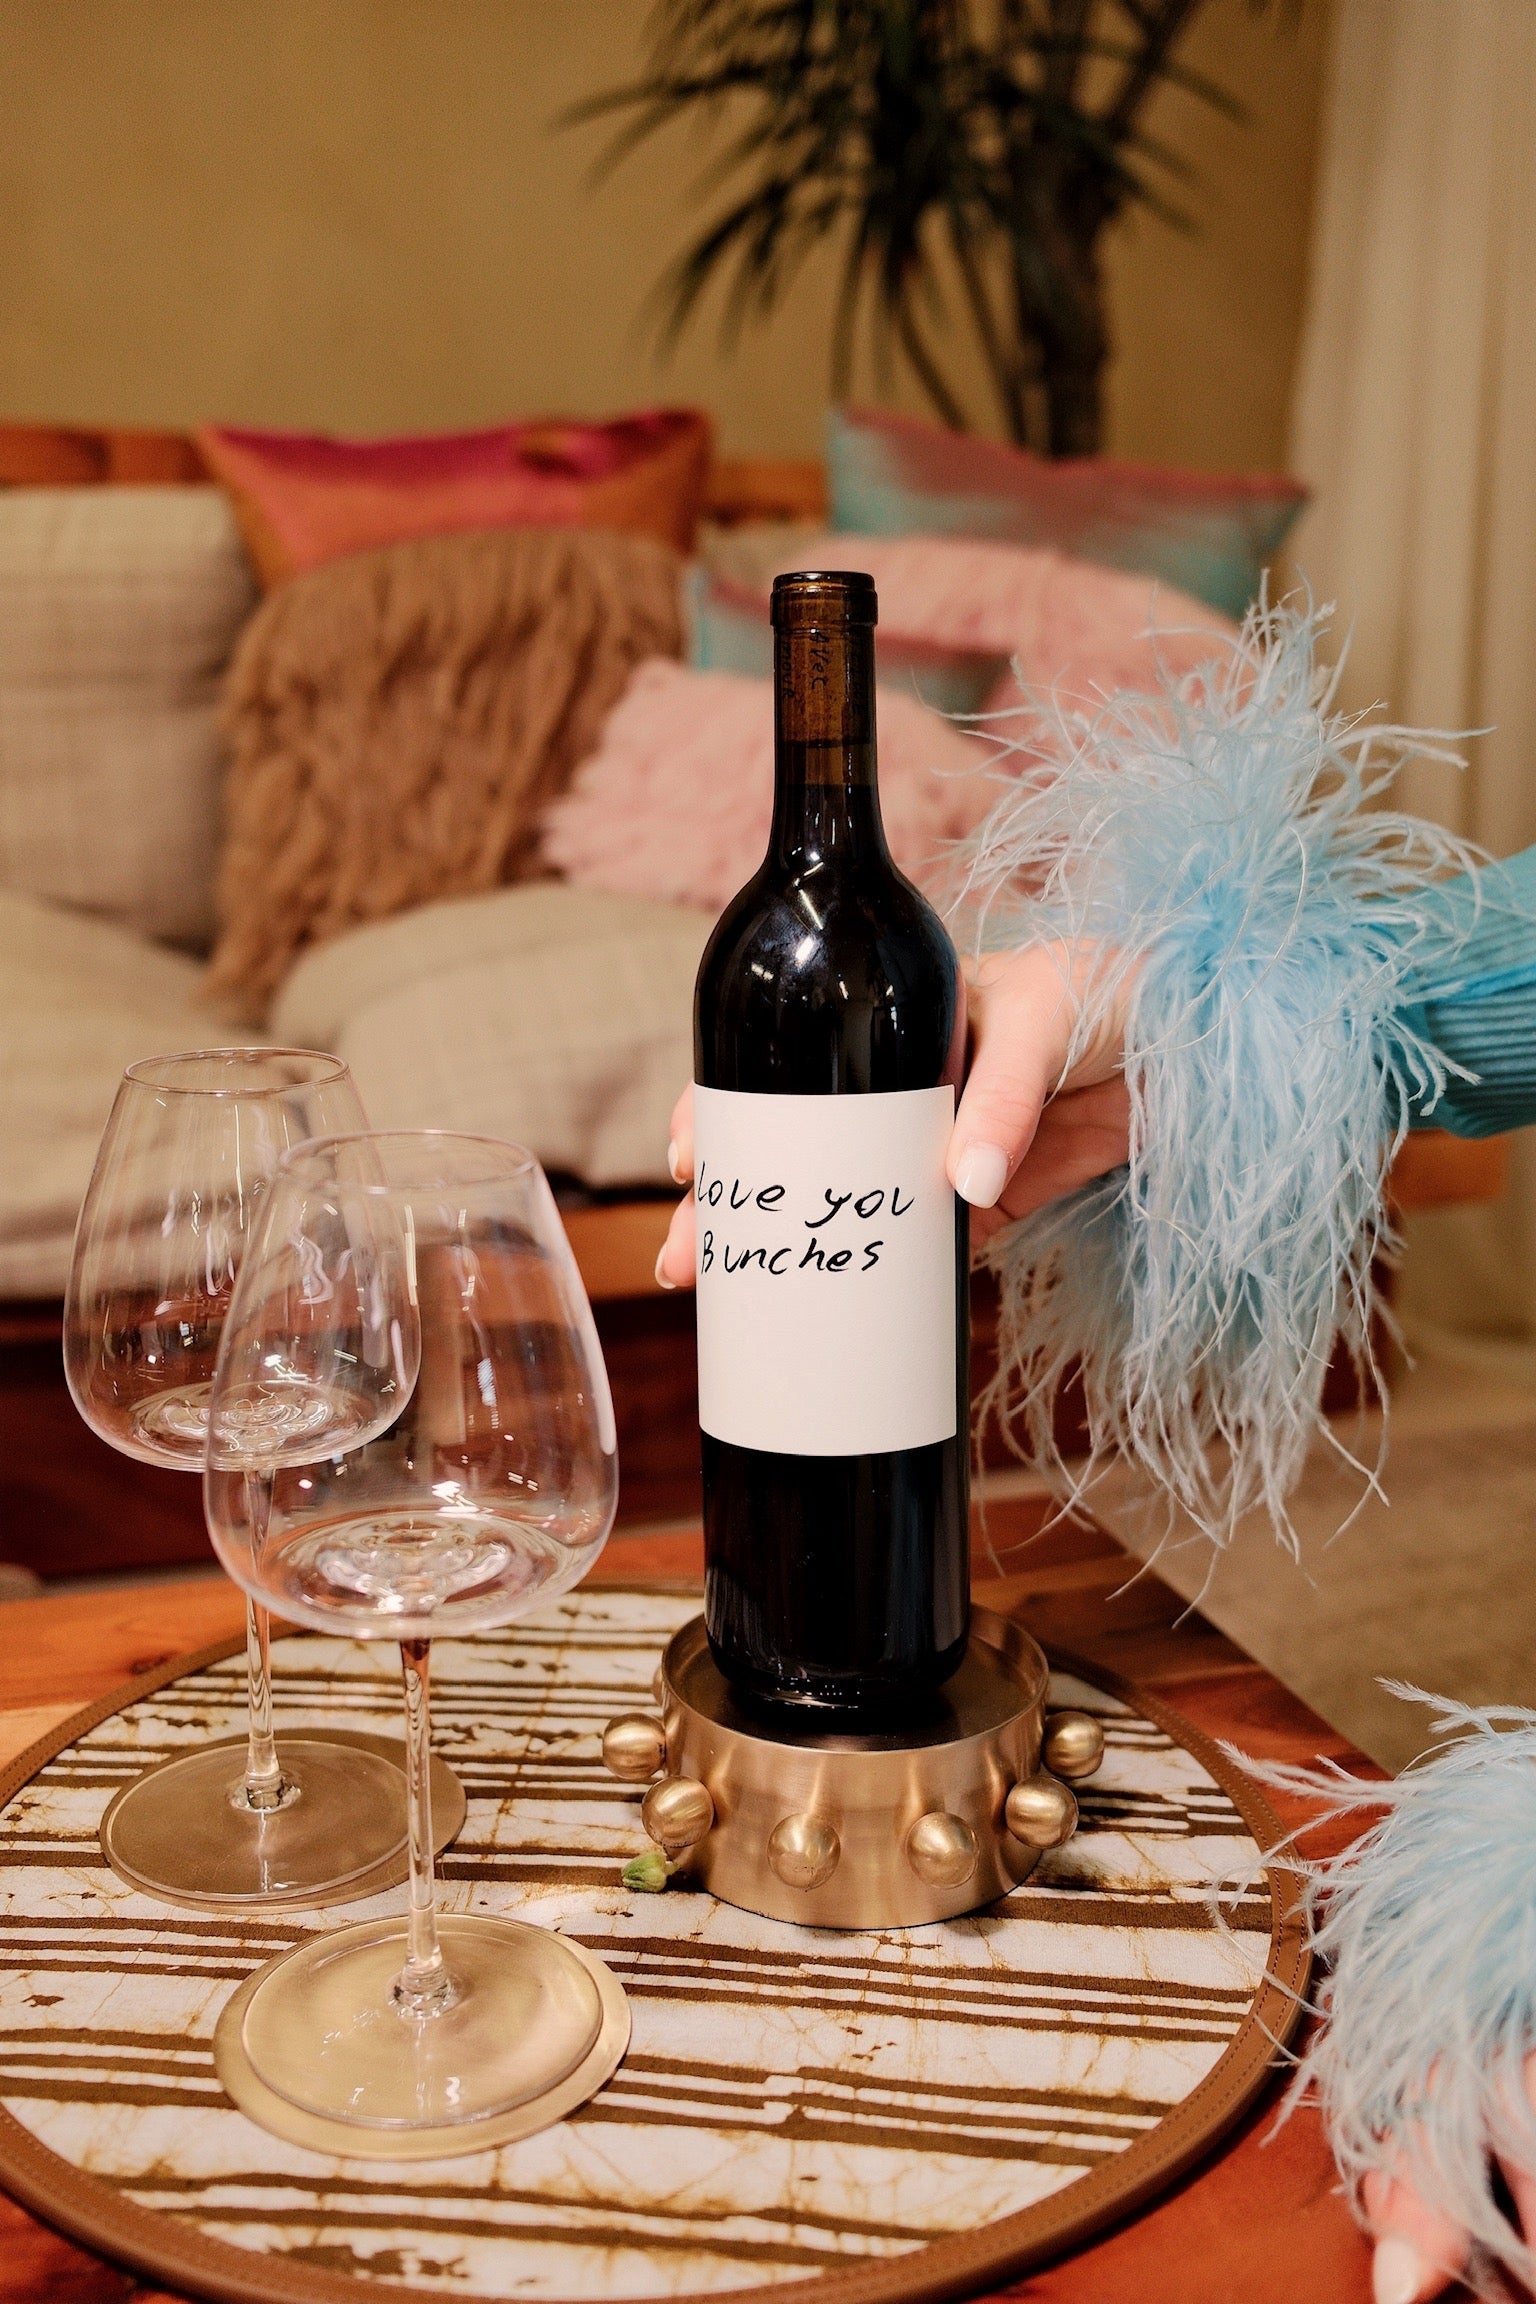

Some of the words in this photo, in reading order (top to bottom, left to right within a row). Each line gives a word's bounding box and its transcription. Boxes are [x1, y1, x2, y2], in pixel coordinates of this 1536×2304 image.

[698, 1160, 786, 1212] Love
[804, 1186, 915, 1229] you
[701, 1230, 884, 1275] Bunches
